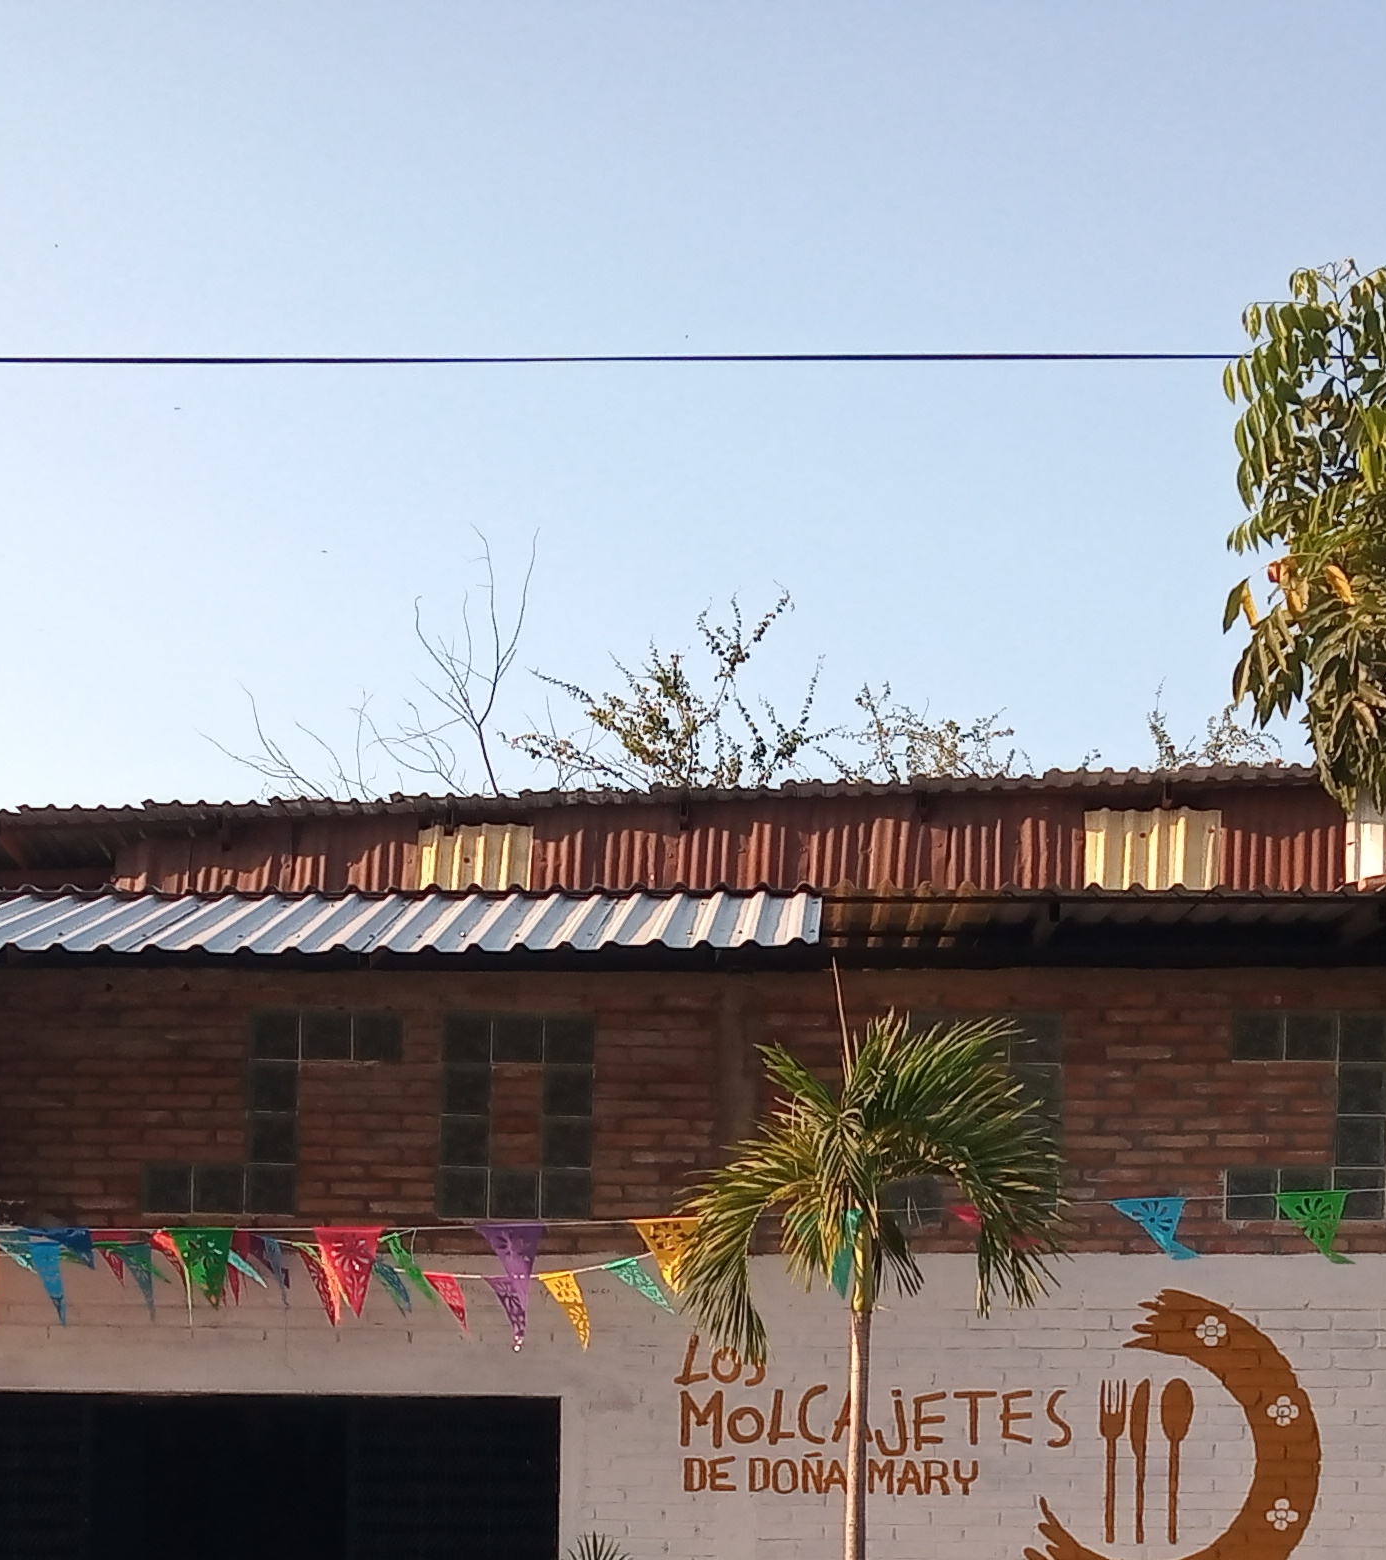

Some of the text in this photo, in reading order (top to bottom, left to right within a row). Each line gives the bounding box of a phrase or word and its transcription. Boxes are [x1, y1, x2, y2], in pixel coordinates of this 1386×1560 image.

[684, 1453, 979, 1496] DE DOÑA MARY
